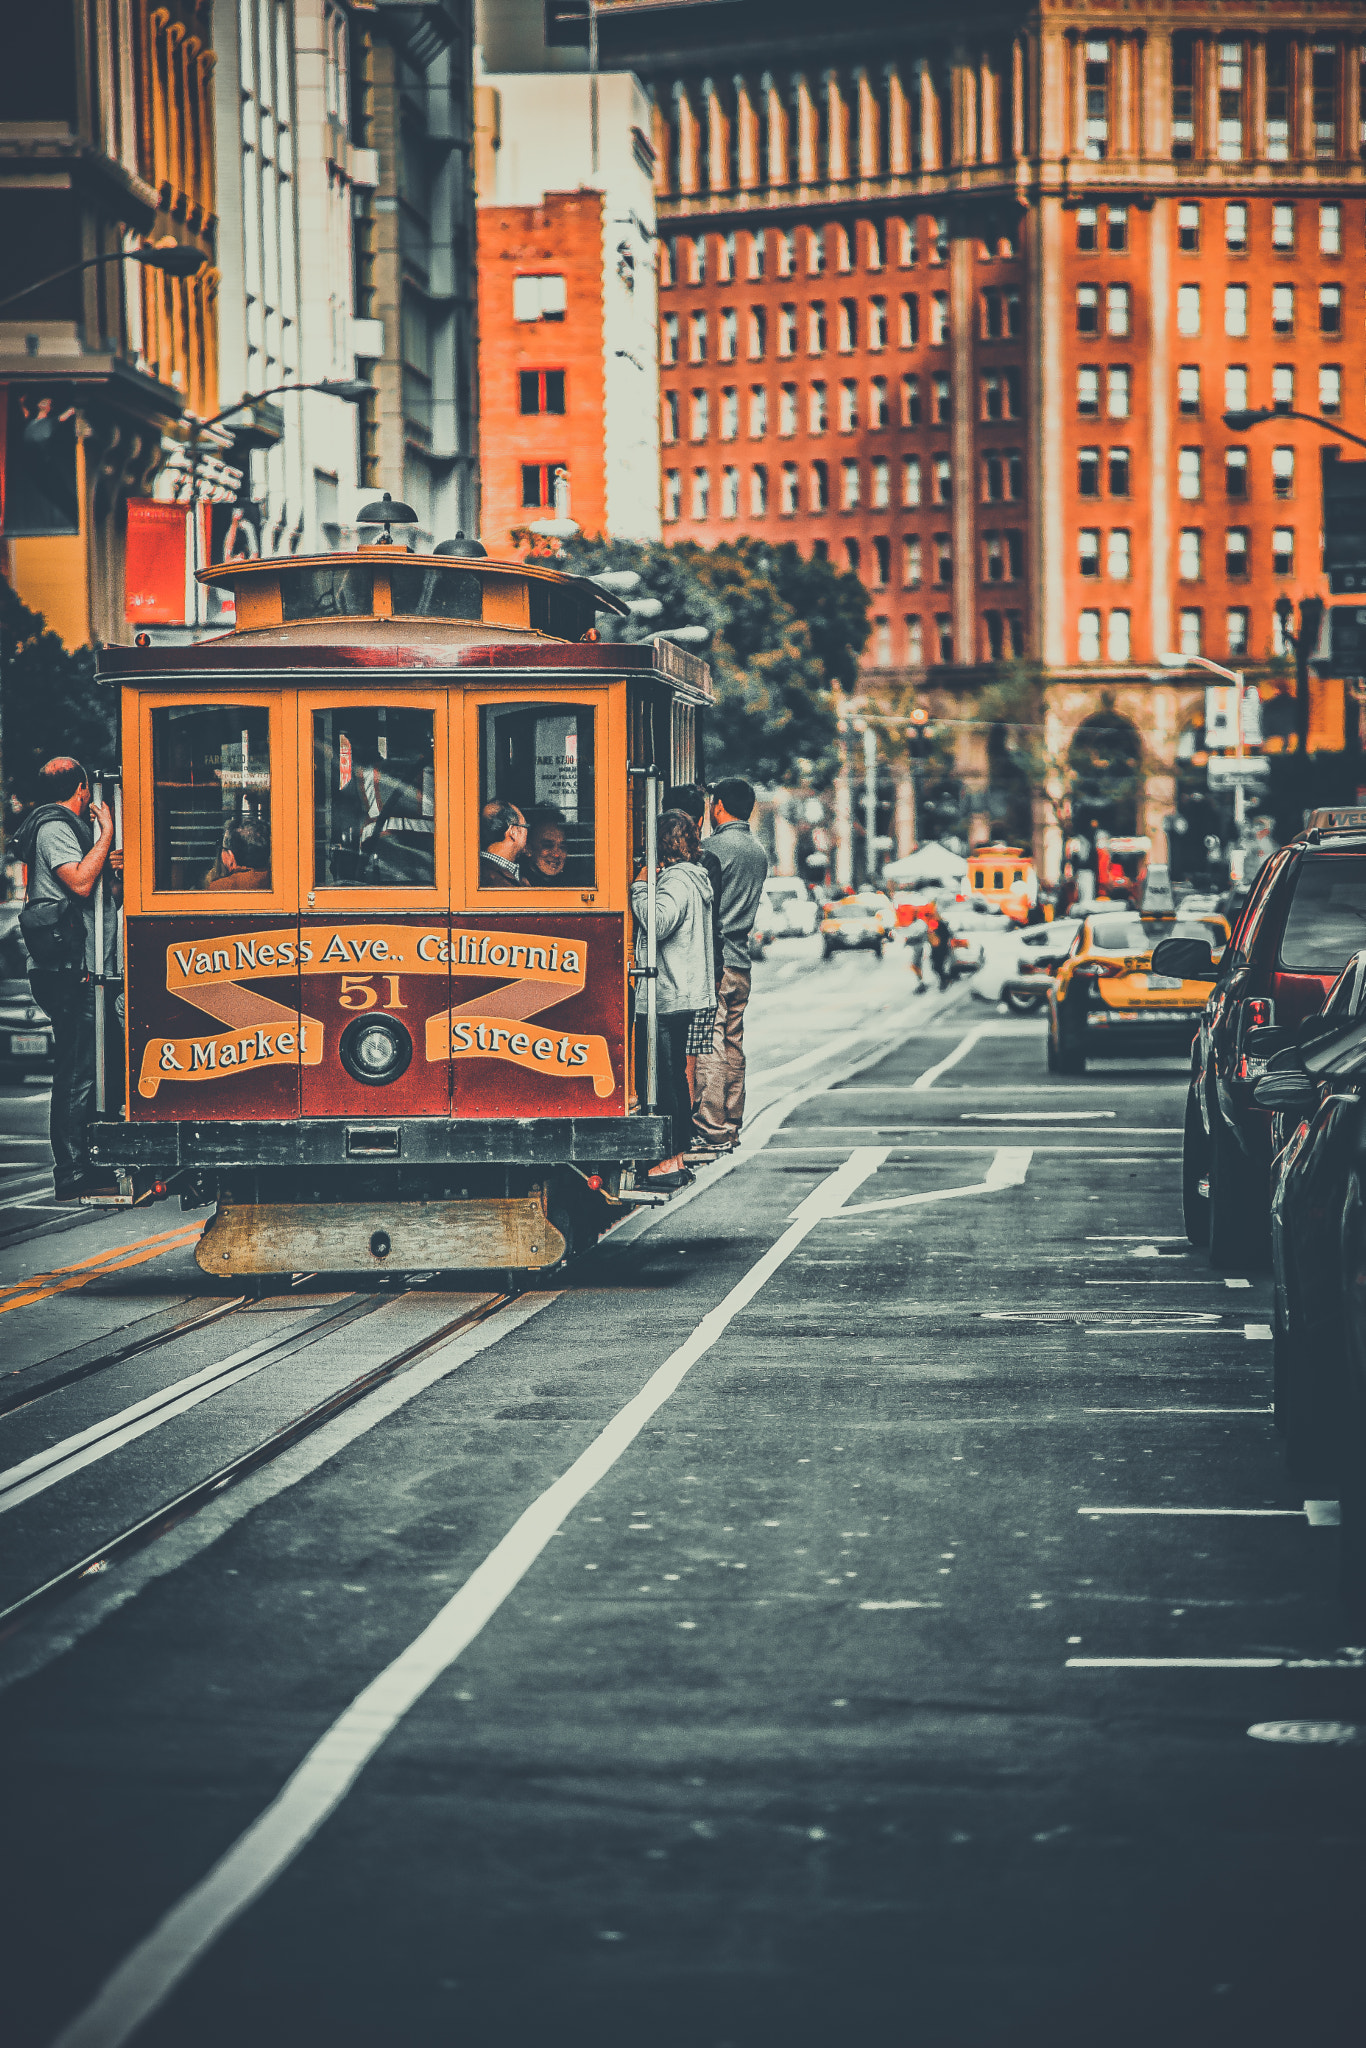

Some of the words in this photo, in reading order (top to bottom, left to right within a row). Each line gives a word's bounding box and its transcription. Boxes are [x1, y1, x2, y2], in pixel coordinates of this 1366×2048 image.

[535, 755, 553, 765] ARE
[173, 947, 231, 977] Van
[235, 936, 314, 970] Ness
[417, 933, 581, 974] California
[338, 975, 409, 1010] 51
[159, 1046, 184, 1071] &
[190, 1028, 309, 1070] Market
[451, 1021, 591, 1067] Streets
